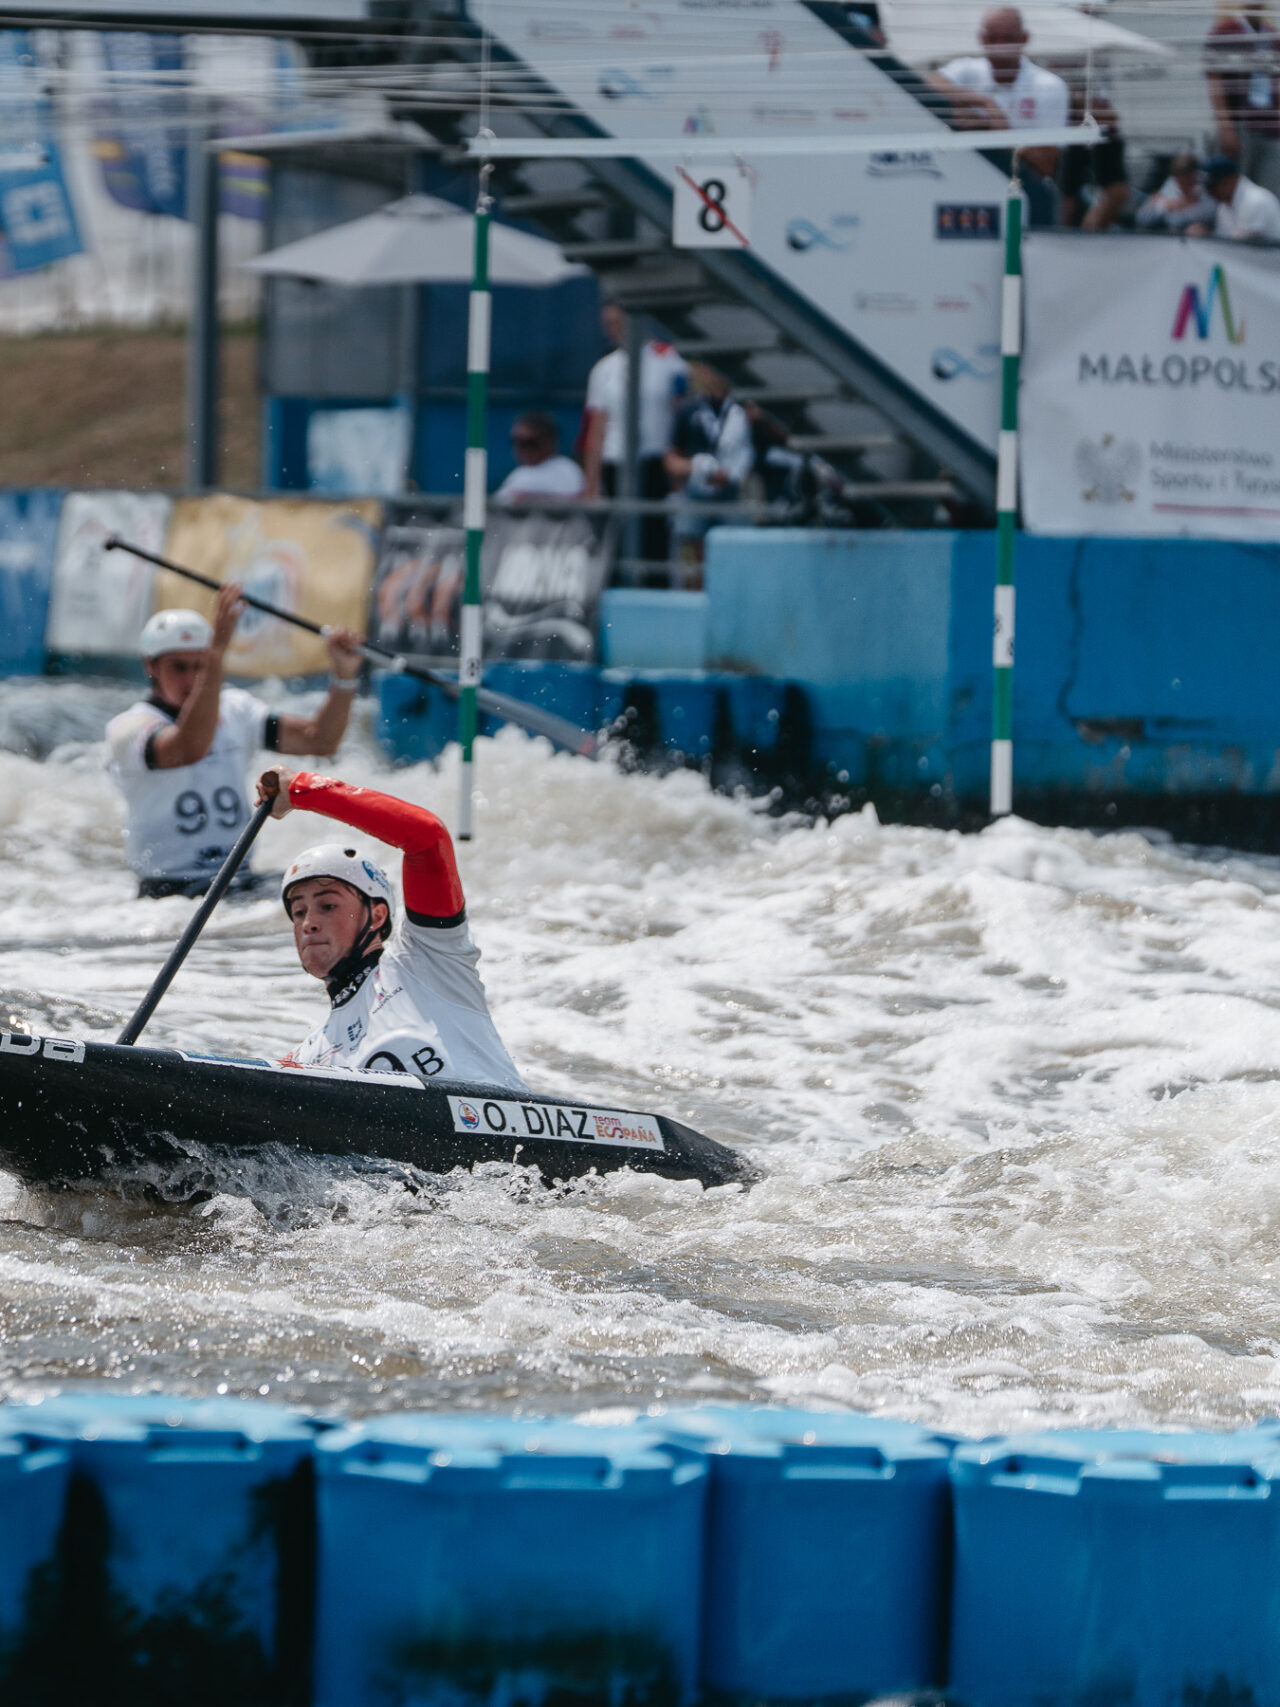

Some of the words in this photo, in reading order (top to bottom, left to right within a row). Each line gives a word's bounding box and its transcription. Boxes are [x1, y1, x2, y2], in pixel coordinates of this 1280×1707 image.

[699, 180, 727, 233] 8
[176, 786, 242, 836] 99
[411, 1046, 445, 1077] B
[483, 1101, 517, 1133] O.
[522, 1105, 596, 1141] DIAZ
